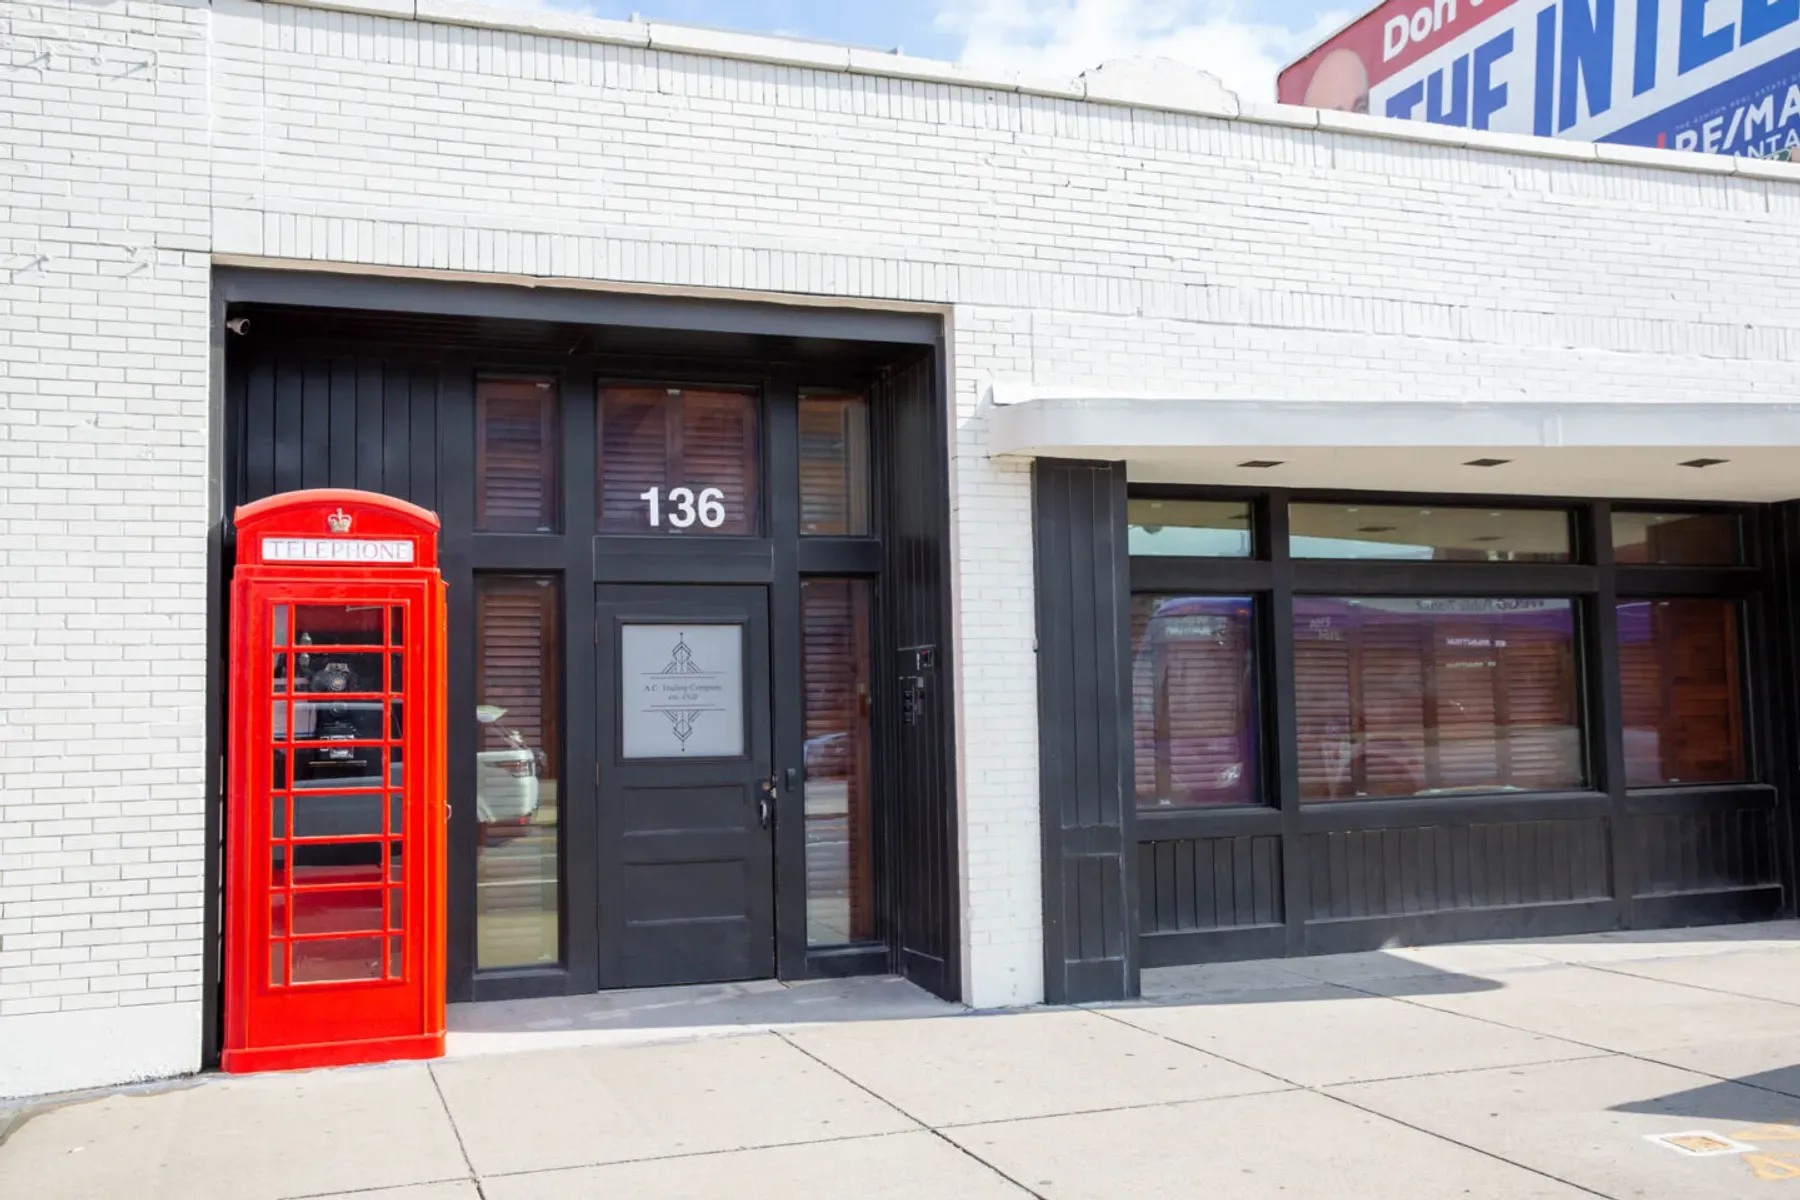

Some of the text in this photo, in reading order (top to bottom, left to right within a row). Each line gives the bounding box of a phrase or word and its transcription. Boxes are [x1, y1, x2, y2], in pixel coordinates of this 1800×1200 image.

[1383, 0, 1483, 62] Don
[640, 486, 725, 528] 136
[270, 541, 408, 560] TELEPHONE
